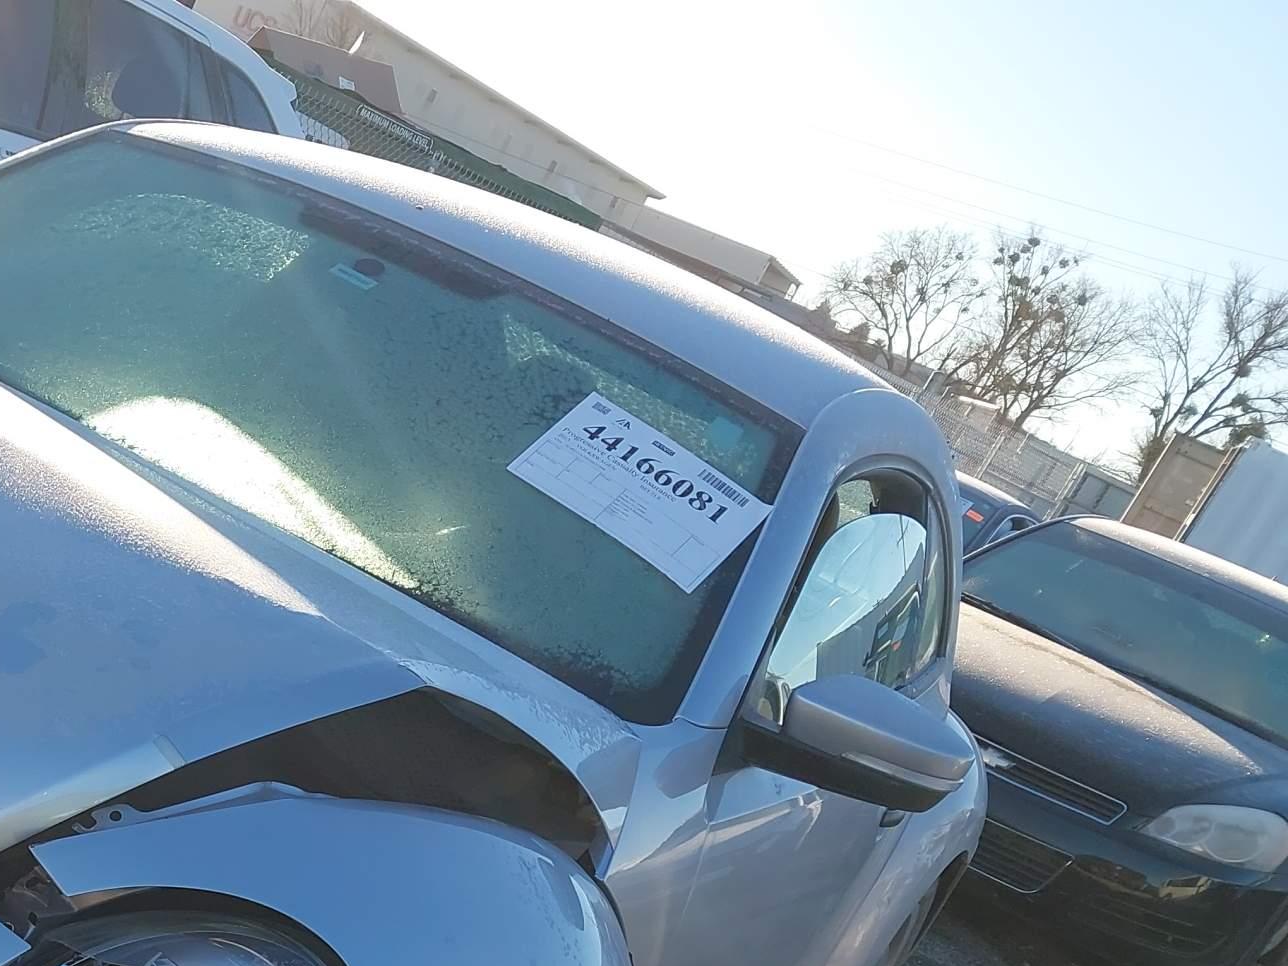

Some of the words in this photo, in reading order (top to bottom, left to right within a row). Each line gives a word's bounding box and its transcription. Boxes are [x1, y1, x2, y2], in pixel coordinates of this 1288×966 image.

[359, 107, 390, 129] MAXIMUM
[389, 120, 414, 141] LOADING
[412, 134, 429, 149] LEVEL
[562, 427, 608, 457] Progressive
[639, 475, 678, 503] Insurance
[581, 423, 730, 526] 44166081
